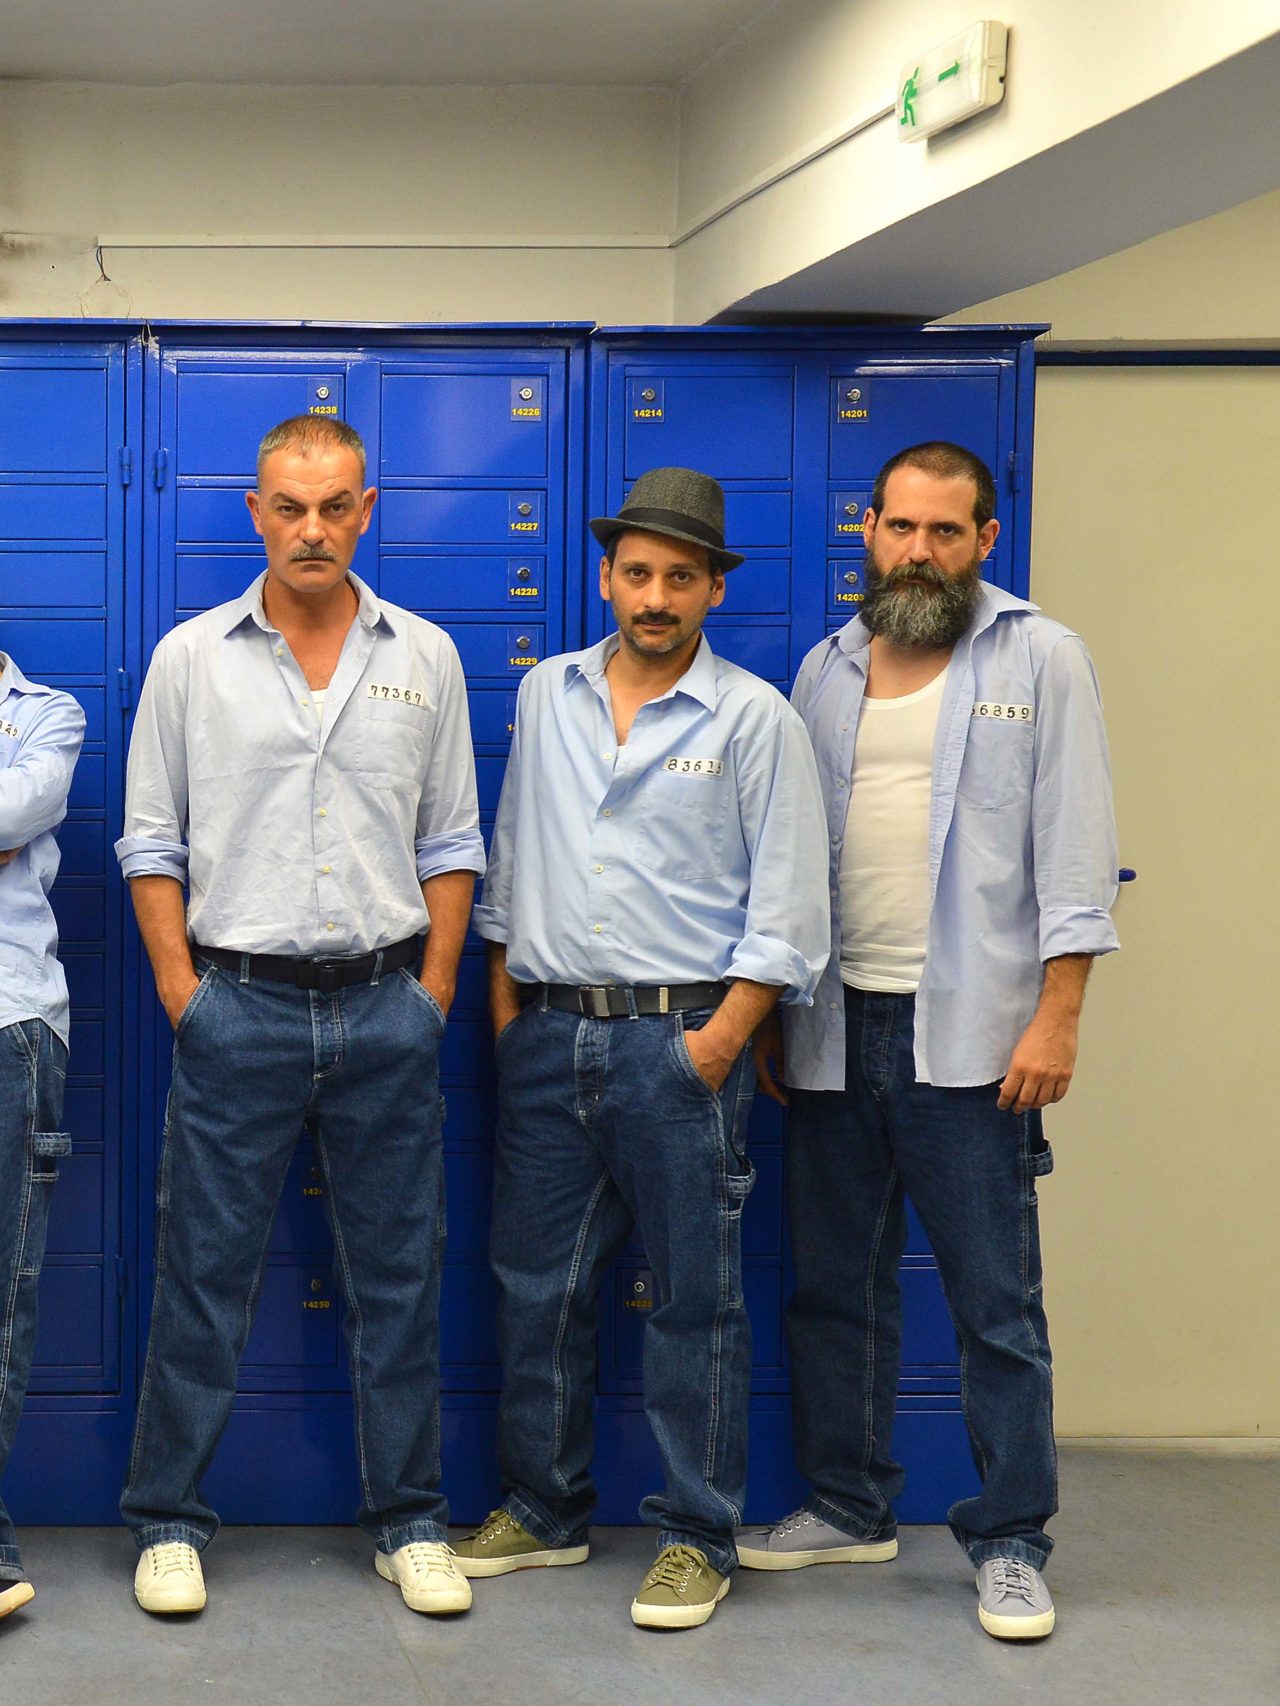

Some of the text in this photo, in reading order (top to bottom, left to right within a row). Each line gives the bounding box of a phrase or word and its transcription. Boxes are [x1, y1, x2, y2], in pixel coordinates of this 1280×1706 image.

[308, 405, 339, 415] 14238
[511, 407, 541, 417] 14226
[633, 408, 664, 418] 14214
[839, 409, 868, 419] 14201
[509, 522, 539, 532] 14227
[836, 523, 865, 533] 14202
[509, 587, 539, 597] 14228
[836, 592, 865, 602] 14203
[509, 657, 538, 666] 14229
[370, 684, 422, 705] 77367
